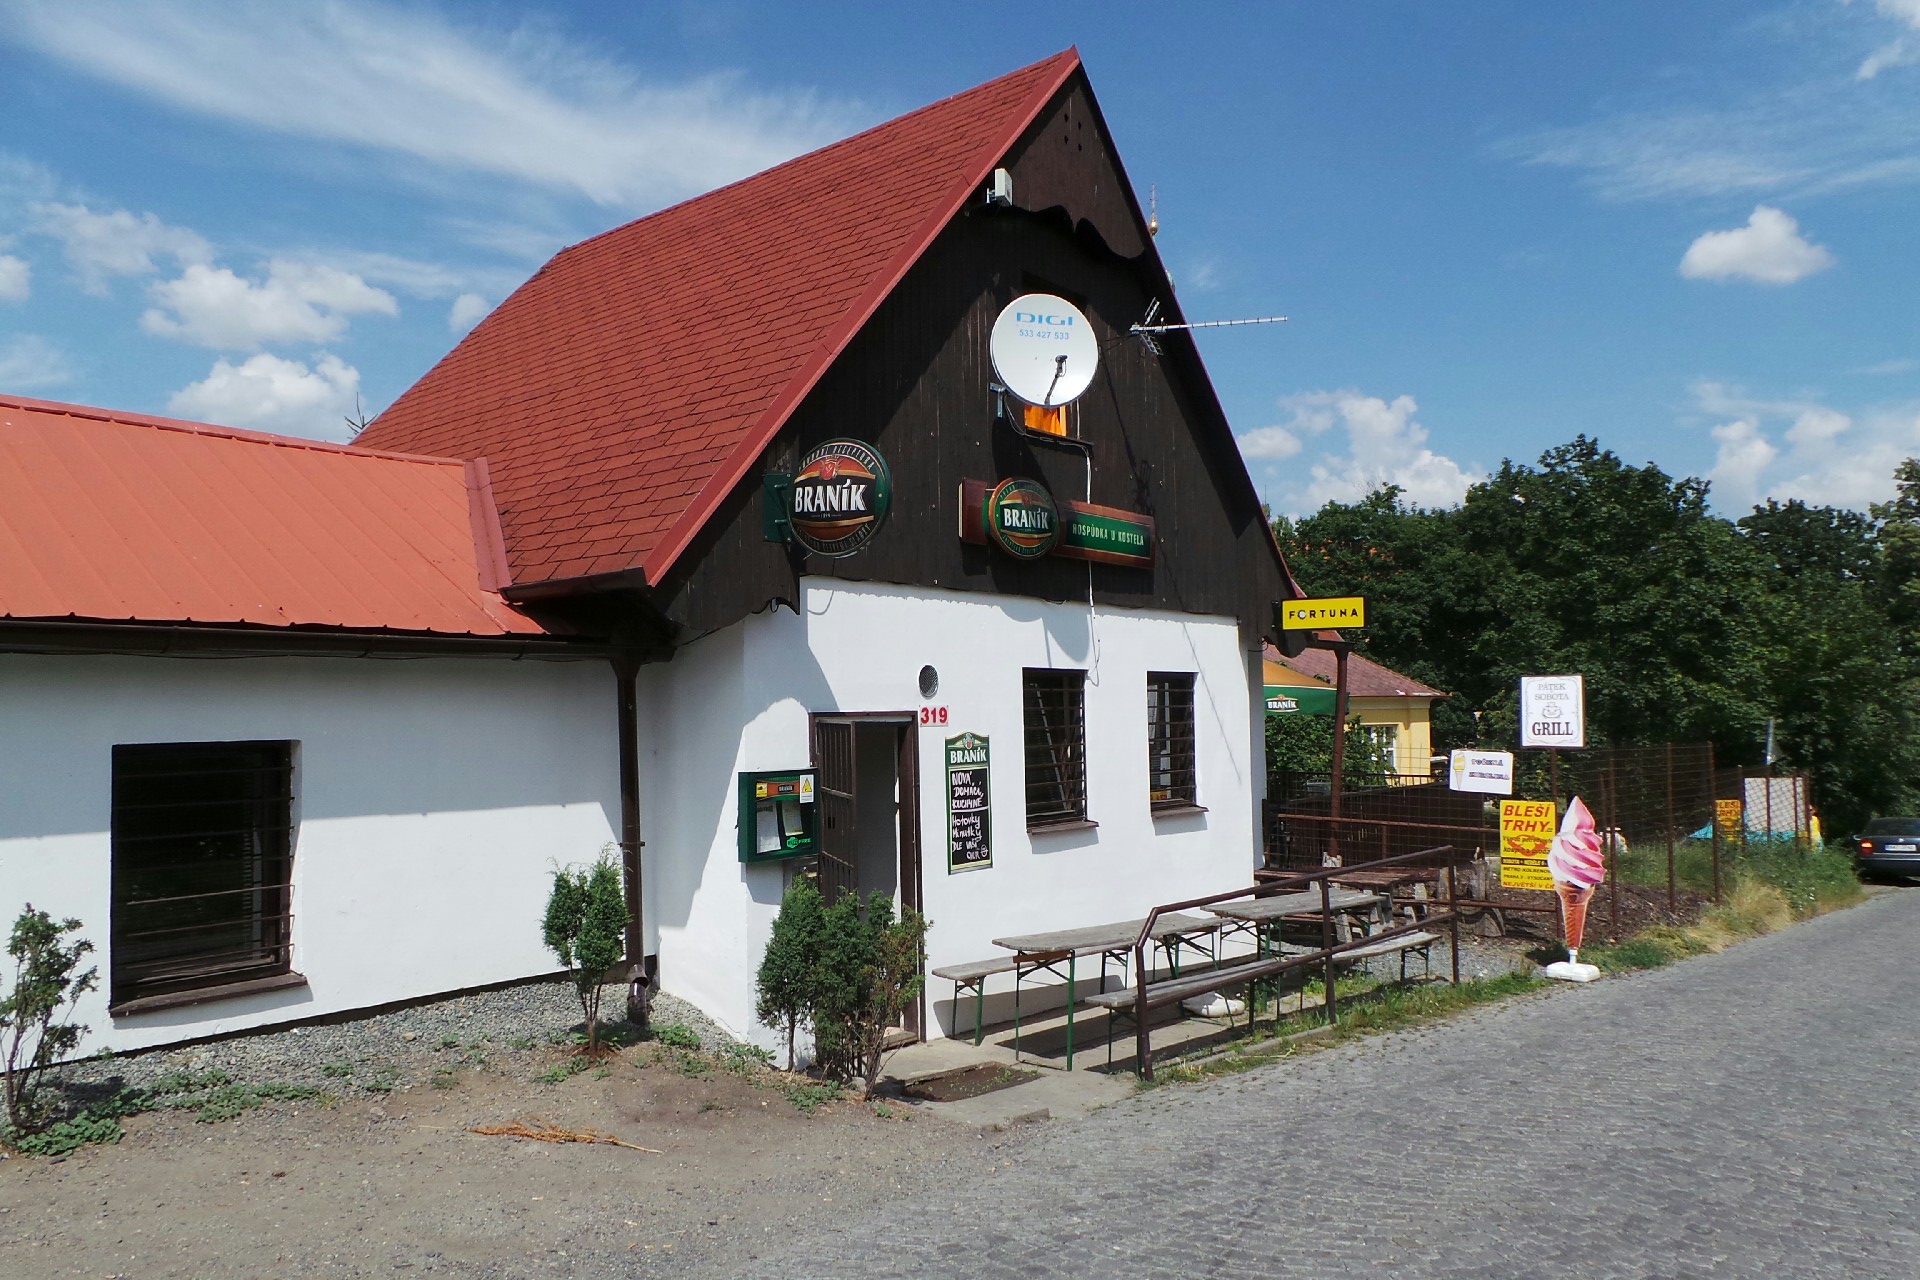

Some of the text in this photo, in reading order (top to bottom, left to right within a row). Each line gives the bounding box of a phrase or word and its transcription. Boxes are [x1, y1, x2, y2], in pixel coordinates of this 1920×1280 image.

[1016, 312, 1073, 326] DIGI
[1019, 329, 1070, 340] 533 427 533
[794, 478, 868, 513] BRANÍK
[1003, 508, 1049, 529] BRANÍK
[1111, 530, 1115, 541] U
[1118, 531, 1144, 546] KOSTELA
[1288, 608, 1359, 621] FORTUNA
[1538, 682, 1566, 691] PÁTEK
[1534, 693, 1569, 701] SOBOTA
[1267, 699, 1297, 710] BRANÍK
[920, 707, 948, 724] 319
[1532, 721, 1573, 736] GRILL
[950, 747, 987, 764] BRANÍK
[951, 771, 972, 786] NOVÁ
[1503, 804, 1552, 818] BLEŠÍ
[952, 812, 981, 829] Hotovky
[1502, 820, 1550, 833] TRHY
